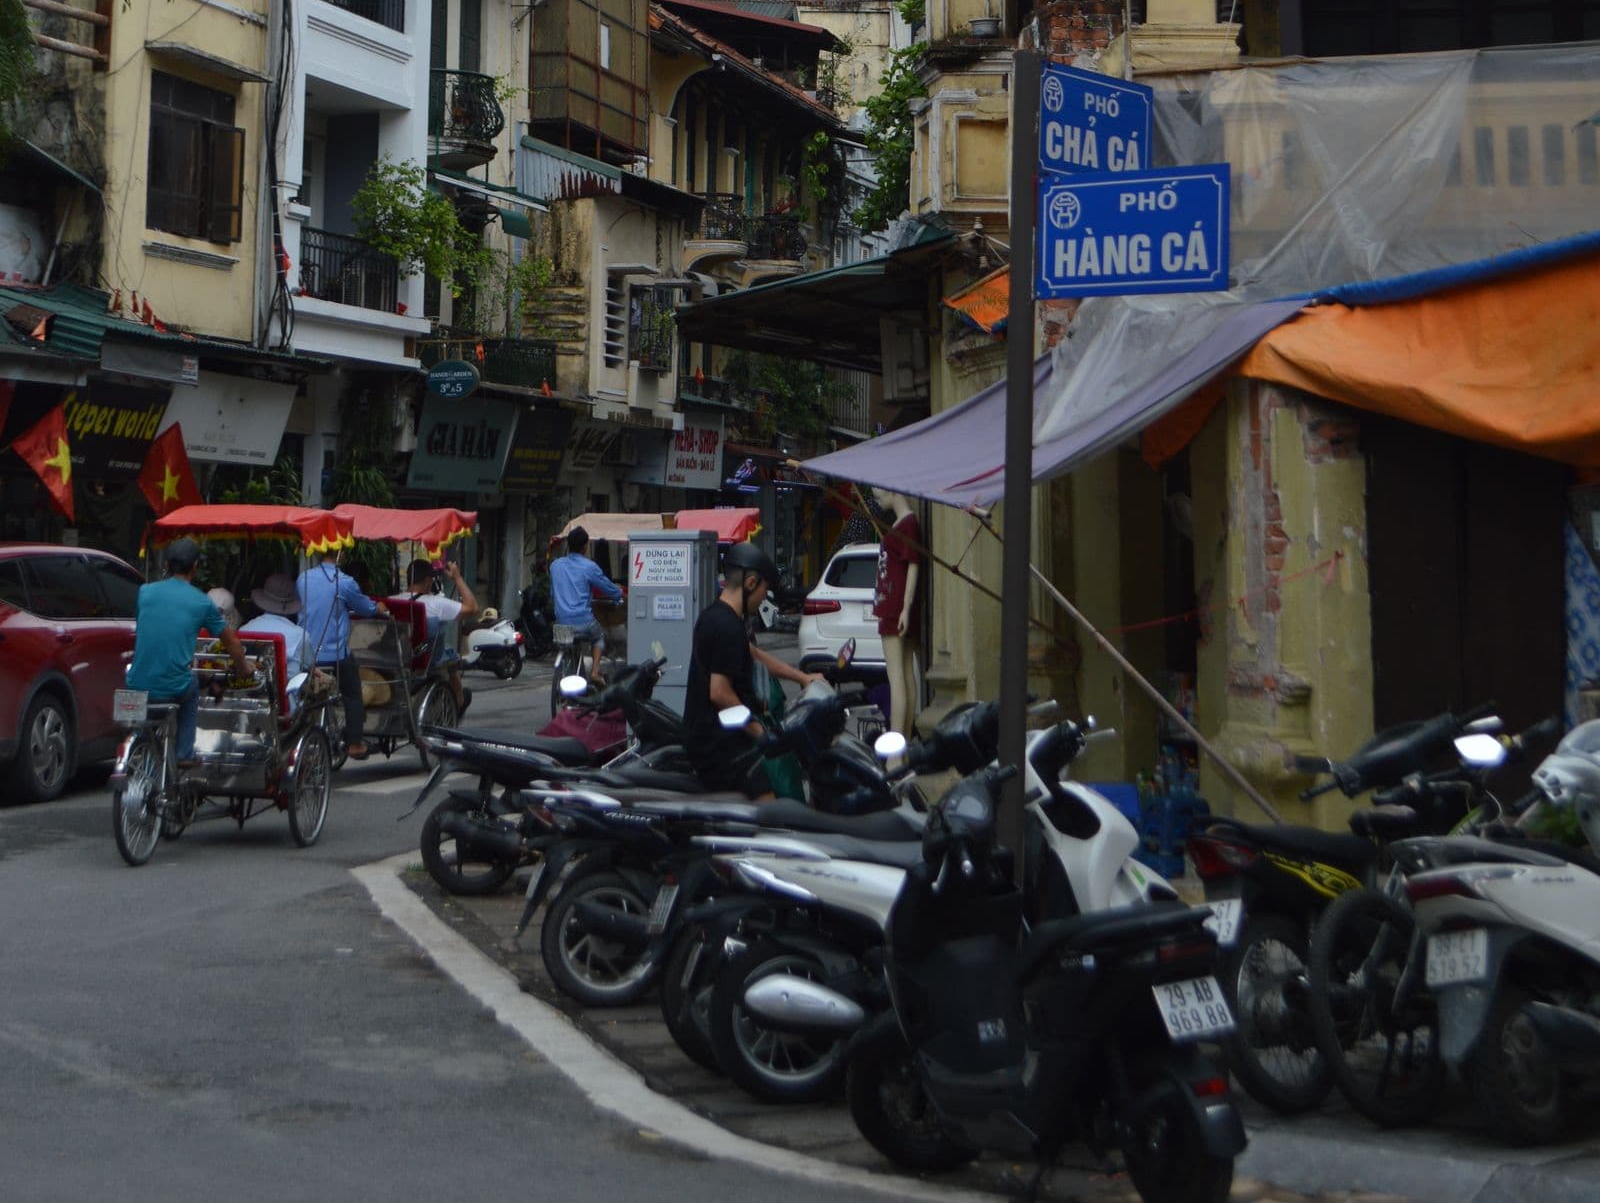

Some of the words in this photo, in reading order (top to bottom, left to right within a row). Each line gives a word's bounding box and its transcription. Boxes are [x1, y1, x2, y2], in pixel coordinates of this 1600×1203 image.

[1084, 92, 1120, 117] PHỐ
[1046, 116, 1098, 168] CHẢ
[1108, 131, 1140, 172] CÁ
[1119, 181, 1180, 212] PHỐ
[1054, 227, 1151, 278] HÀNG
[1161, 221, 1209, 272] CÁ
[112, 403, 165, 442] world
[698, 429, 719, 454] SHOP
